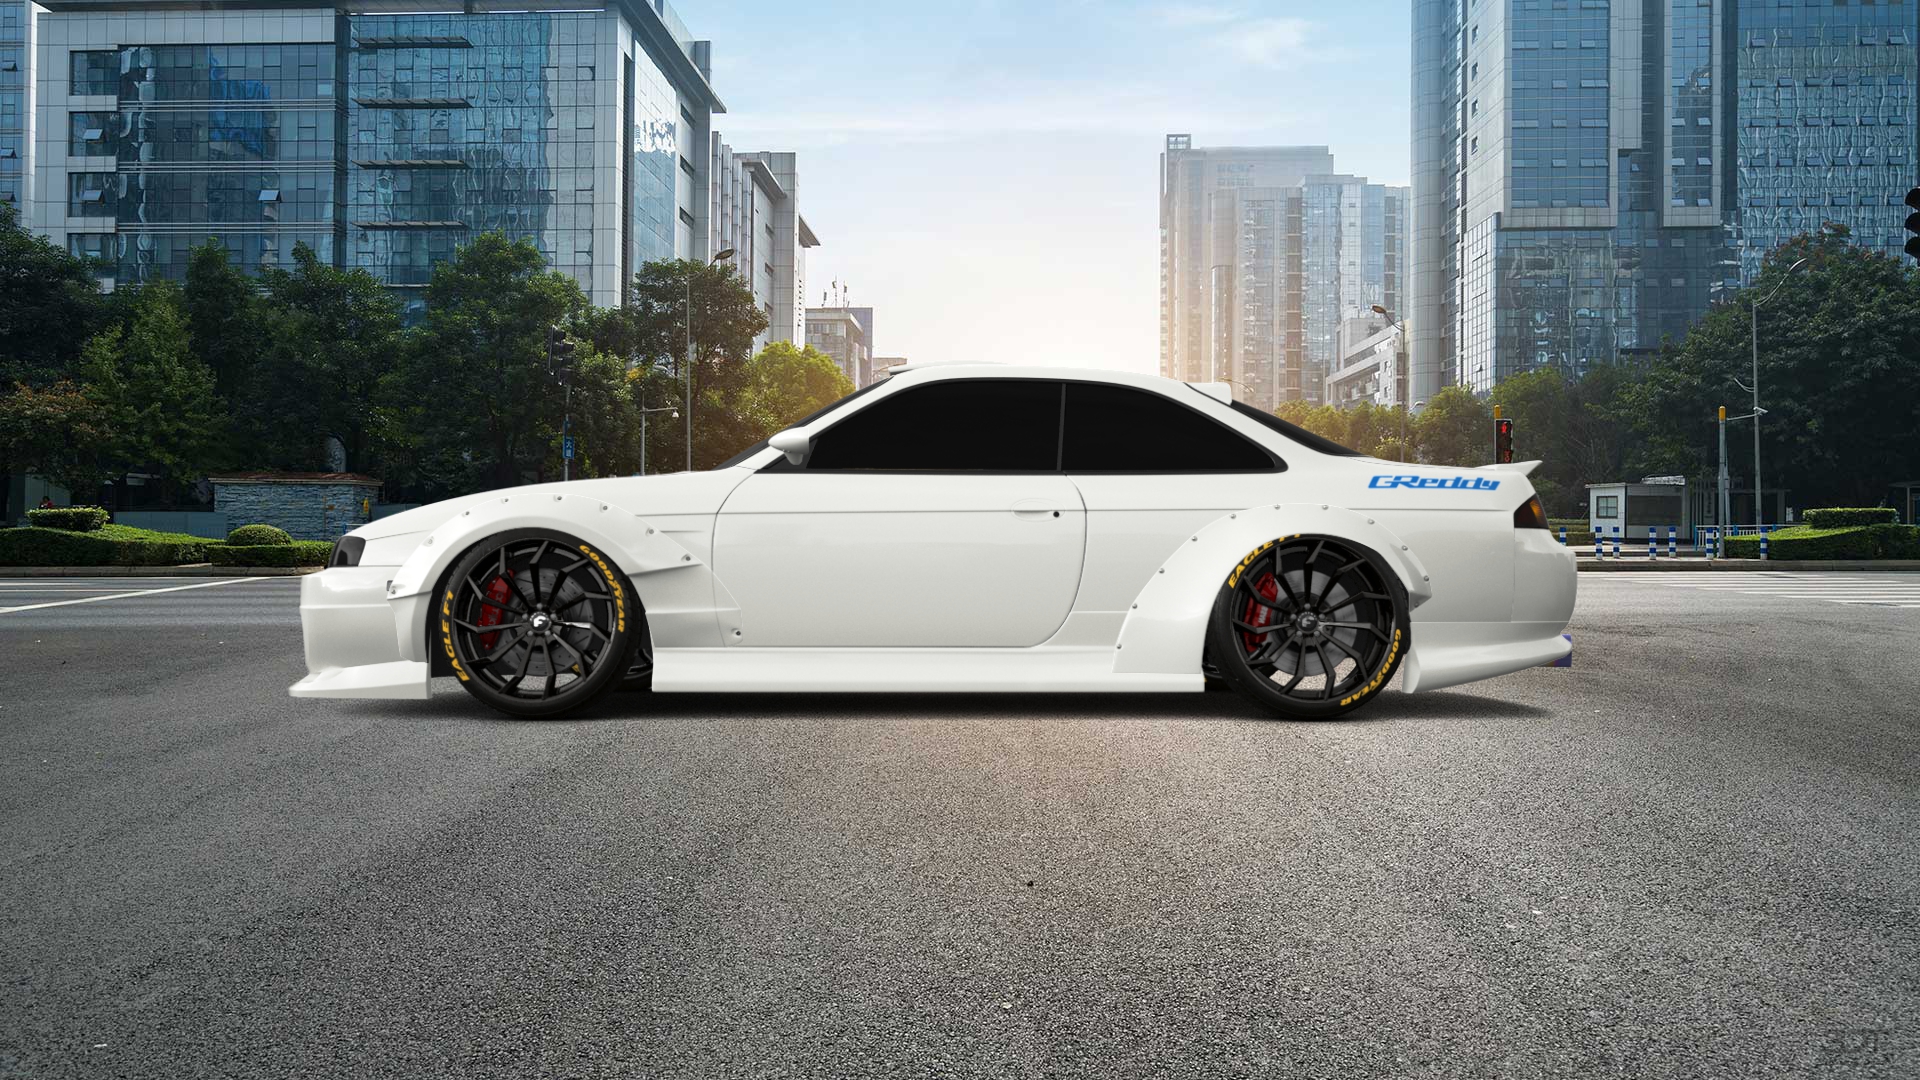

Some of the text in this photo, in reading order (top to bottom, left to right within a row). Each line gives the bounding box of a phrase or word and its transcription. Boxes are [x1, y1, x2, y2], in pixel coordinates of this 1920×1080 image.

[1368, 475, 1501, 491] GReddy
[579, 545, 625, 633] GOODYEAR
[1228, 540, 1274, 589] EAGLE
[442, 590, 470, 681] EAGLE F1
[1340, 628, 1402, 706] GOODYEAR
